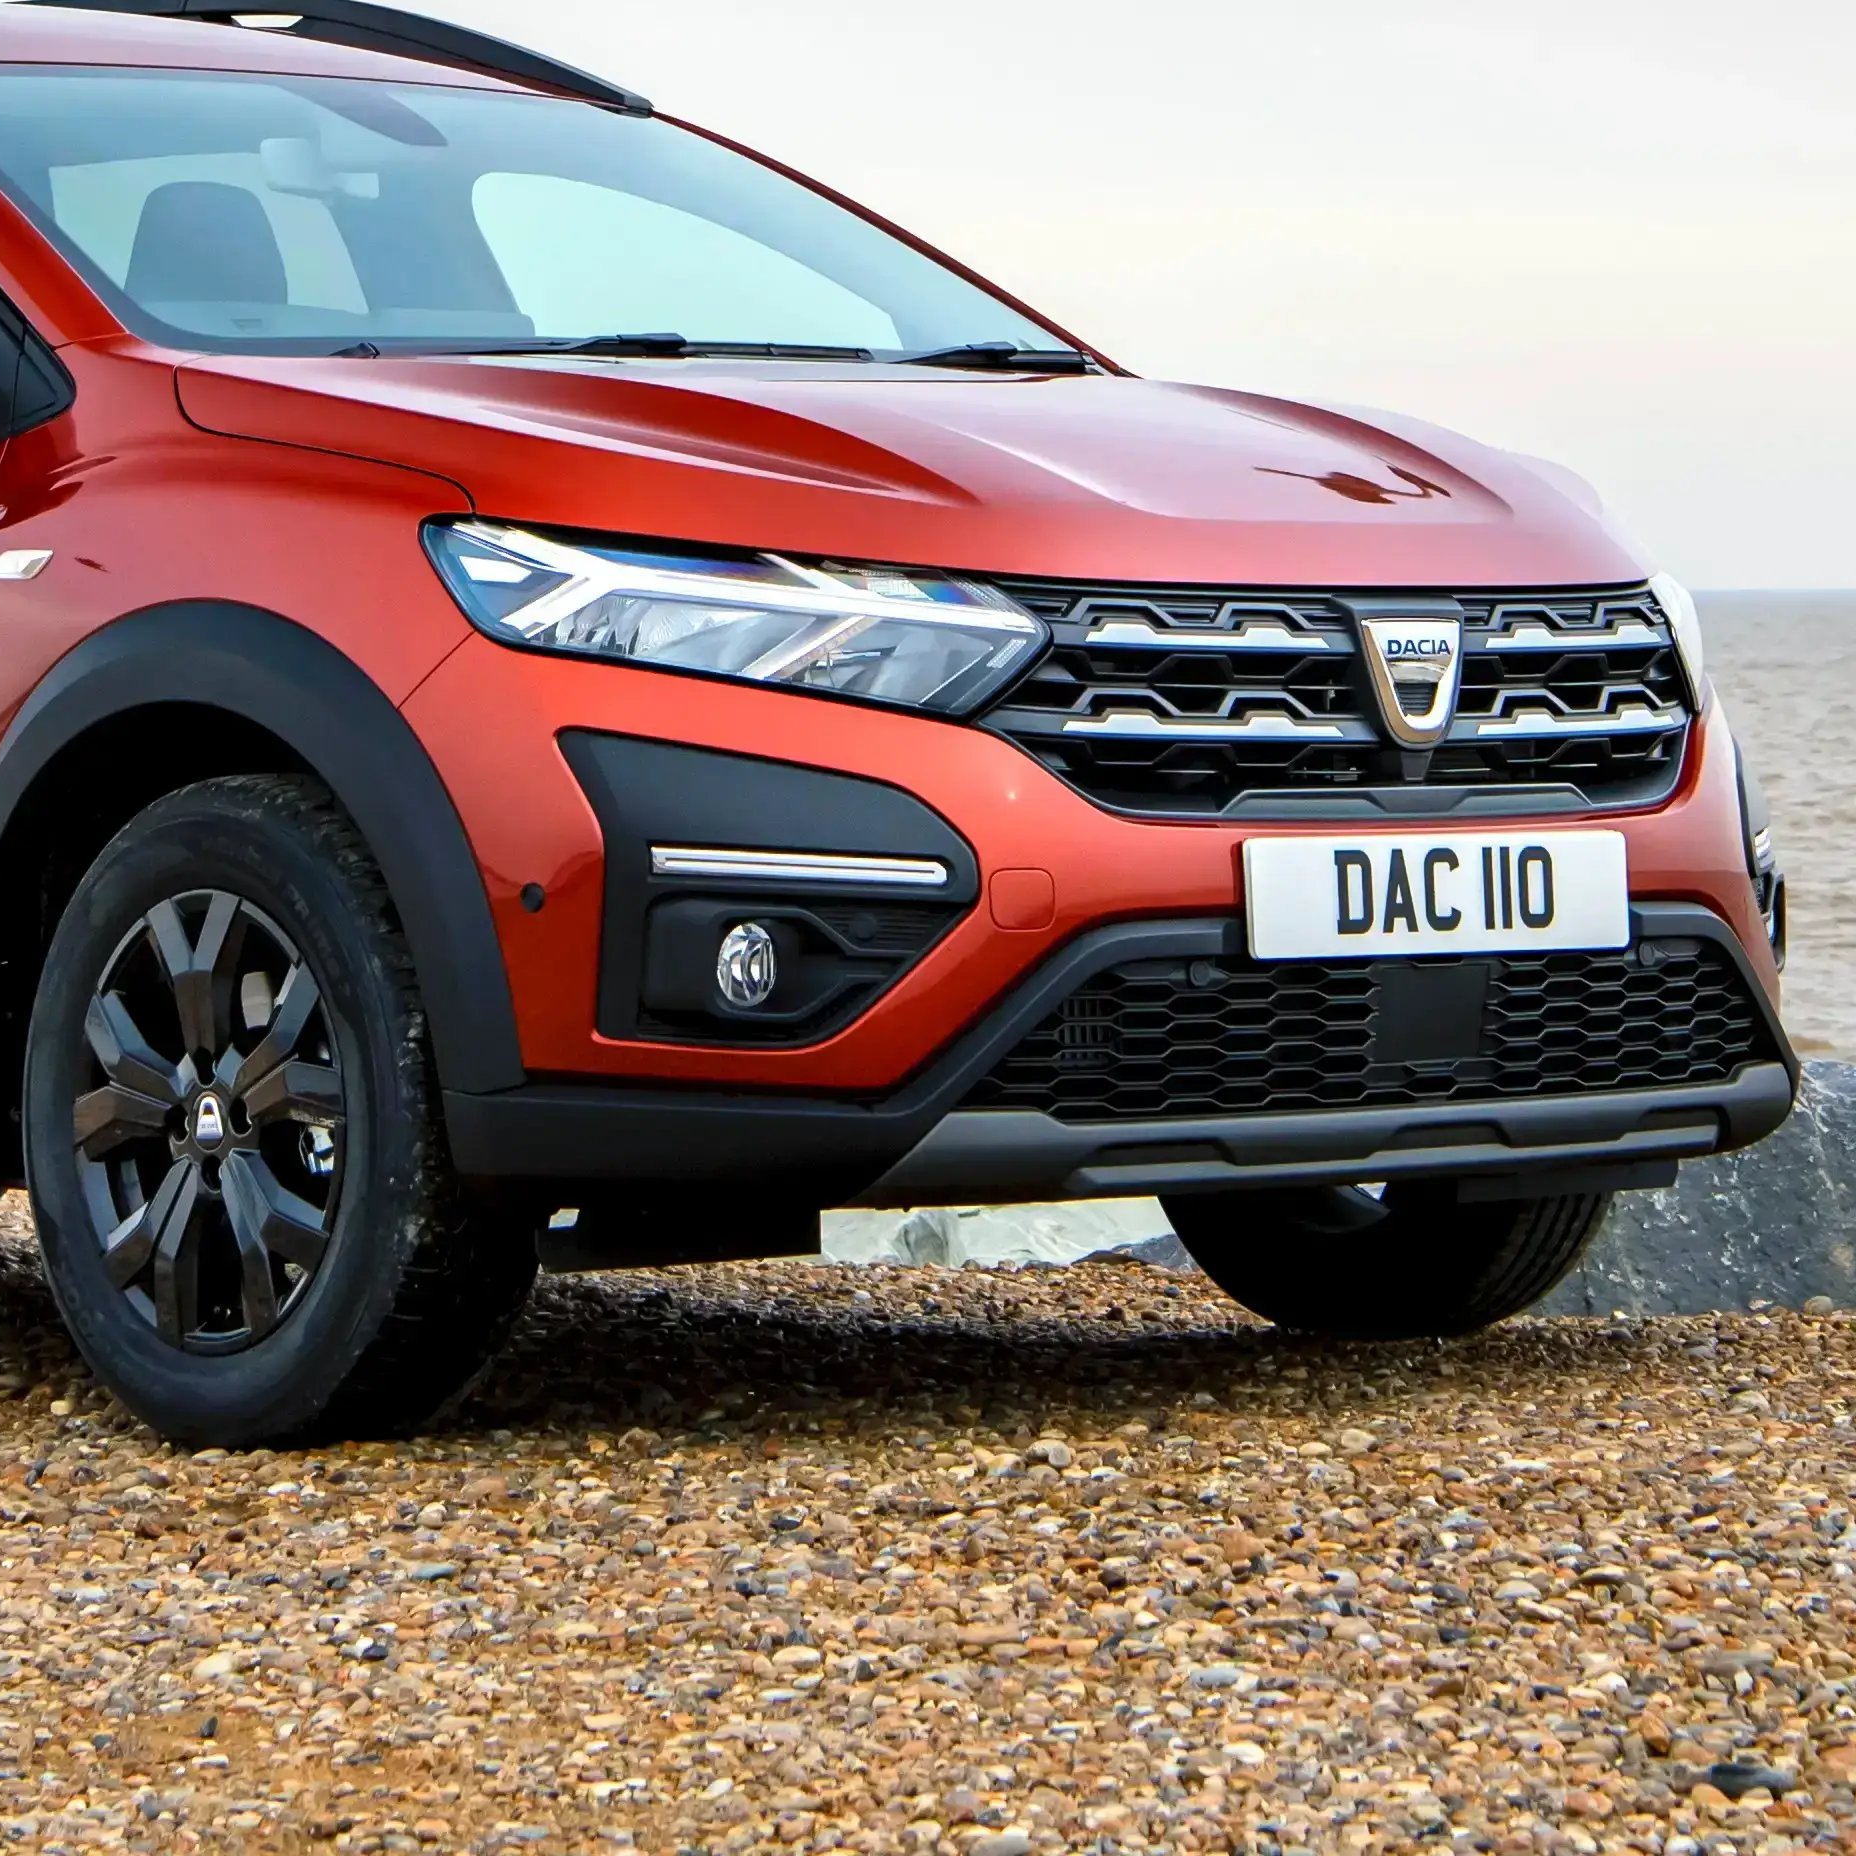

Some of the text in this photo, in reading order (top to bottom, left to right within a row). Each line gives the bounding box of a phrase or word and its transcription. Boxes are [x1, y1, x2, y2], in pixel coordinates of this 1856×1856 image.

[1387, 639, 1451, 655] DACIA
[1333, 845, 1555, 935] DAC 110
